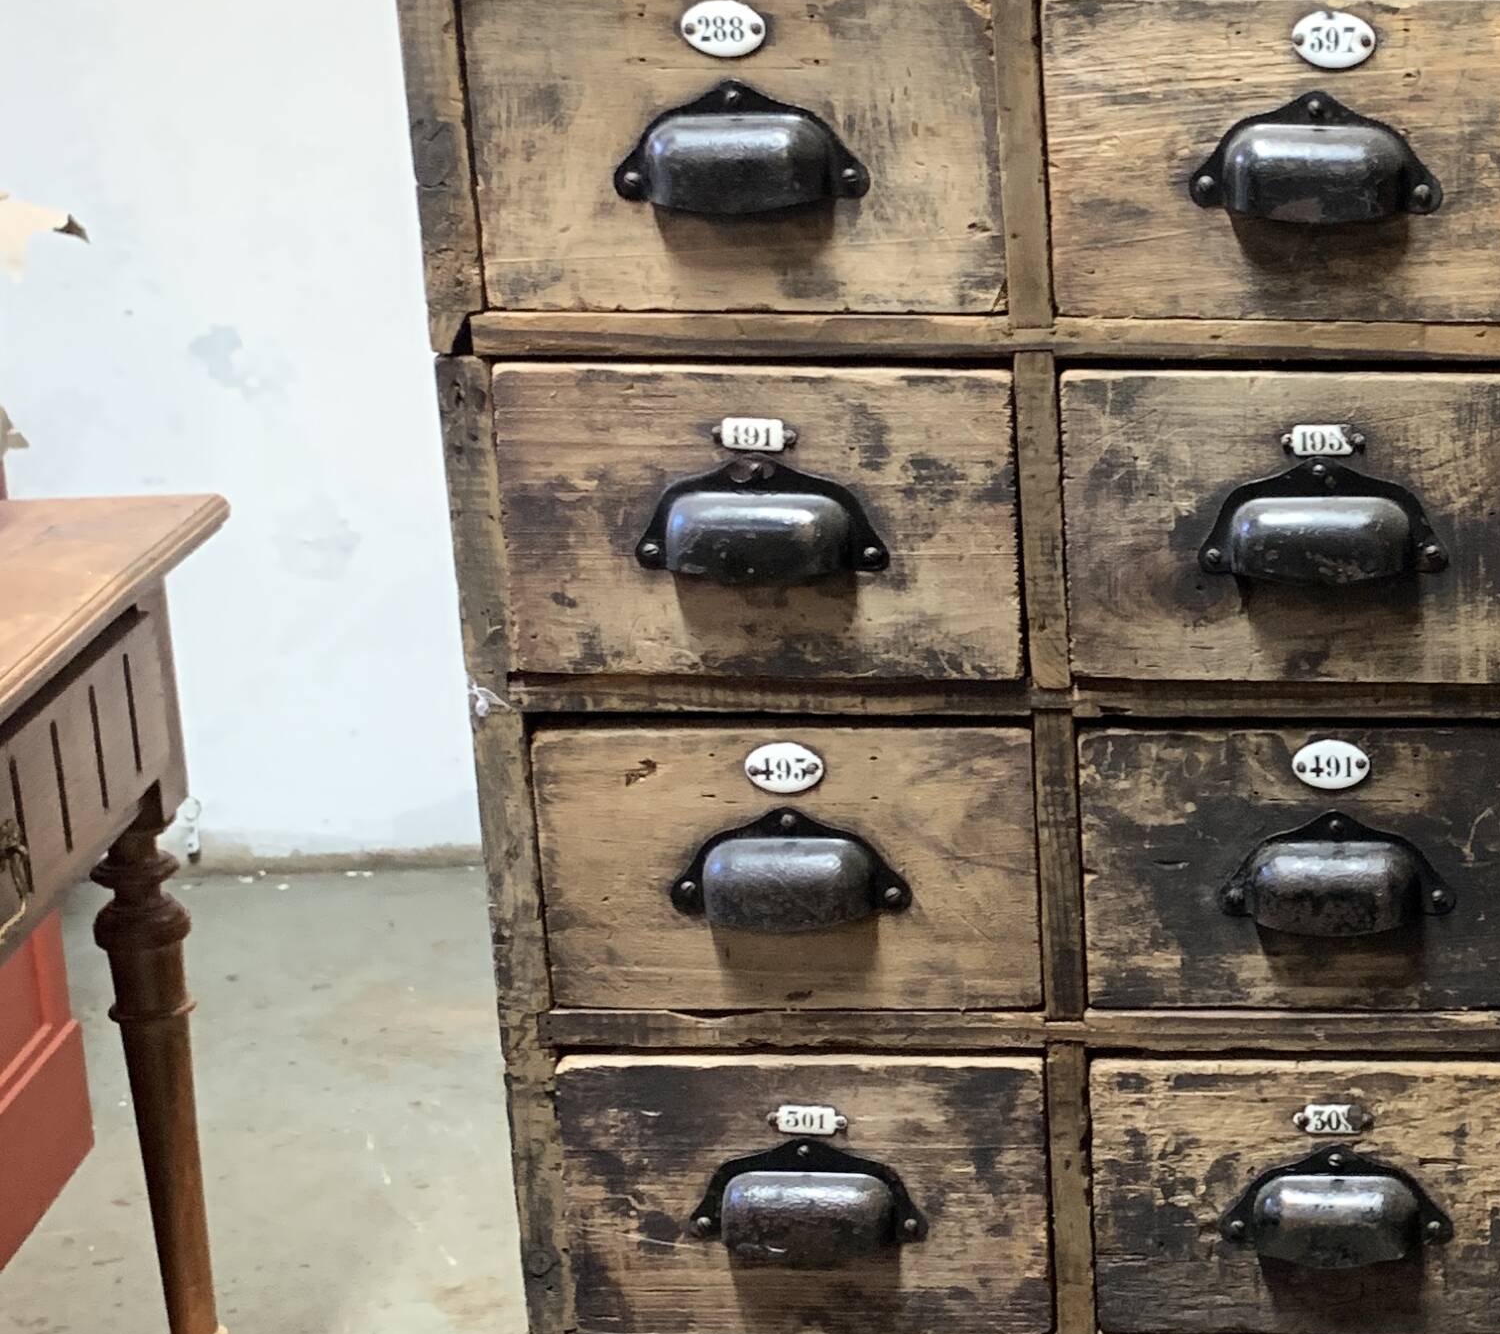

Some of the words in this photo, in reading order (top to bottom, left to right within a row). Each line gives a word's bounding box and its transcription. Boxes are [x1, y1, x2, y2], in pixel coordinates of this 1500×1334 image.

[697, 16, 744, 42] 288
[1301, 431, 1344, 452] 195
[1310, 755, 1353, 778] 491
